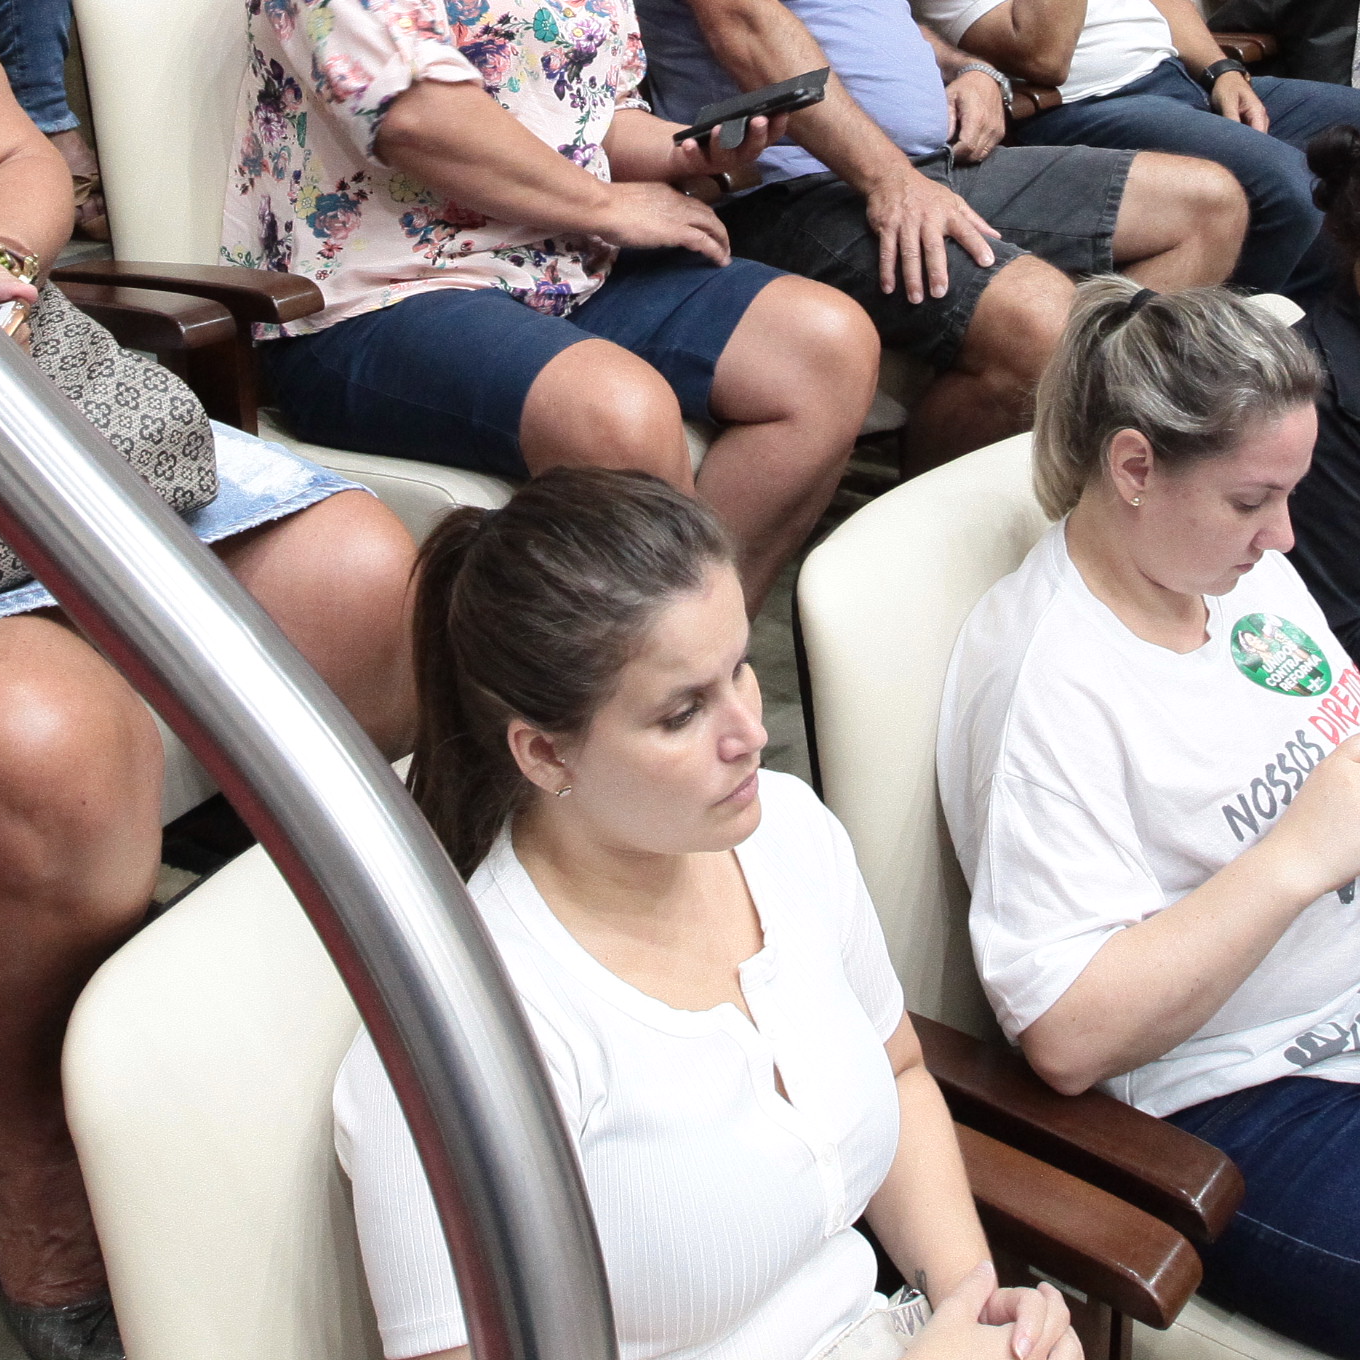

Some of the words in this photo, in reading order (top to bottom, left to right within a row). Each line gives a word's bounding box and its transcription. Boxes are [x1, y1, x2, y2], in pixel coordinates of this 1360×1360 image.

[1262, 643, 1298, 673] UNIDOS
[1265, 655, 1303, 687] CONTRA
[1279, 654, 1322, 691] REFORMA
[1221, 729, 1326, 842] NOSSOS
